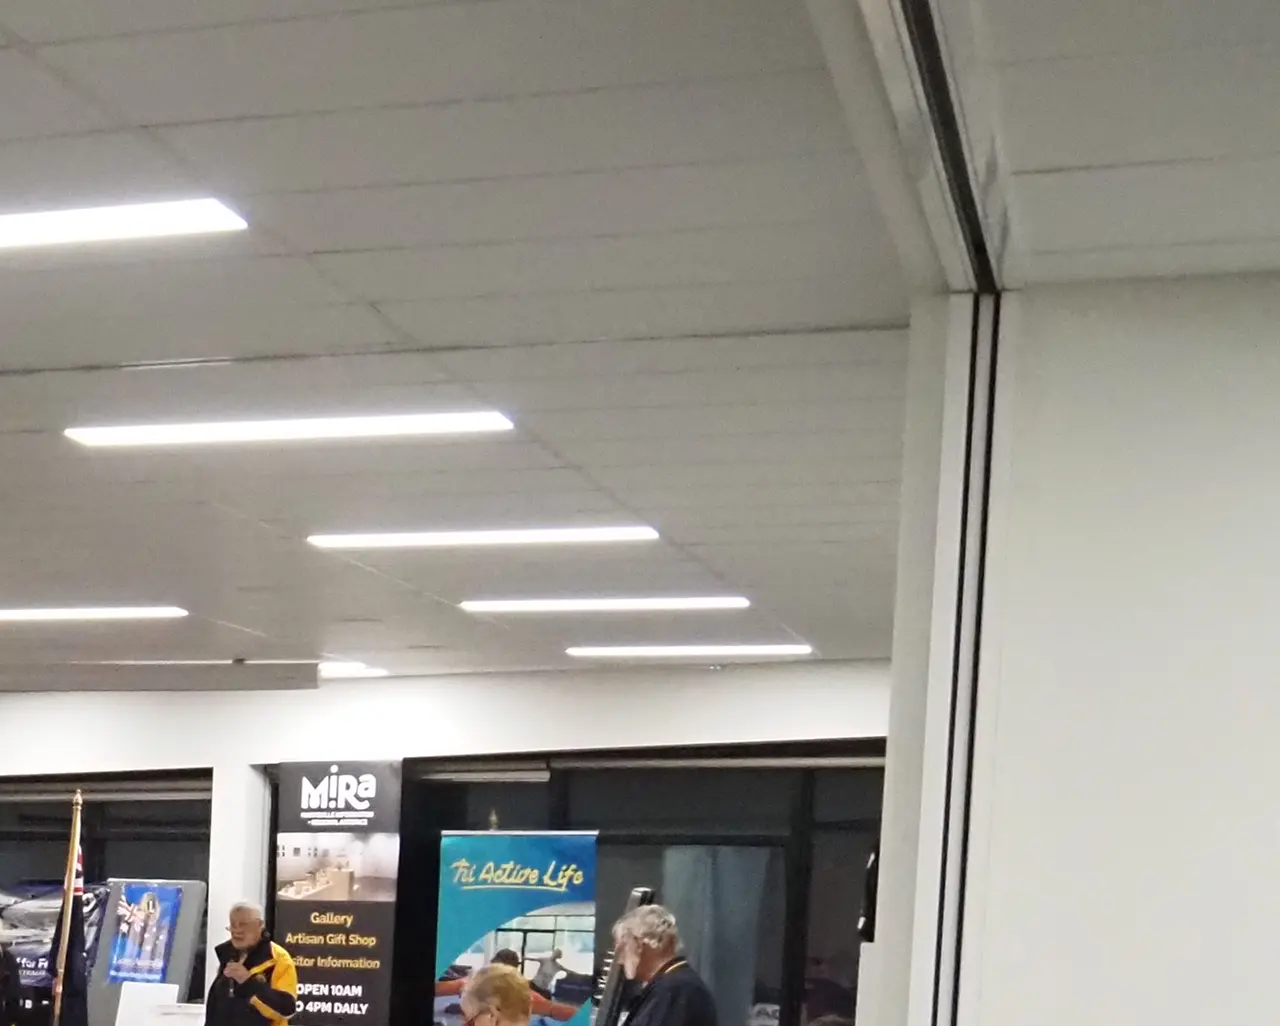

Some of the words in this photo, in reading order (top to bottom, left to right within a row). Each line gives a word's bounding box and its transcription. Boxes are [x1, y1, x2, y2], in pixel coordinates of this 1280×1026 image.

[479, 861, 538, 884] Active
[543, 861, 584, 889] Life
[310, 912, 353, 927] Gallery
[285, 932, 324, 945] Artisan
[326, 934, 346, 945] Gift
[349, 934, 376, 948] Shop
[317, 956, 380, 969] Information
[296, 983, 328, 995] OPEN
[331, 985, 362, 997] 10AM
[306, 1001, 332, 1013] 4PM
[334, 1003, 368, 1015] DAILY
